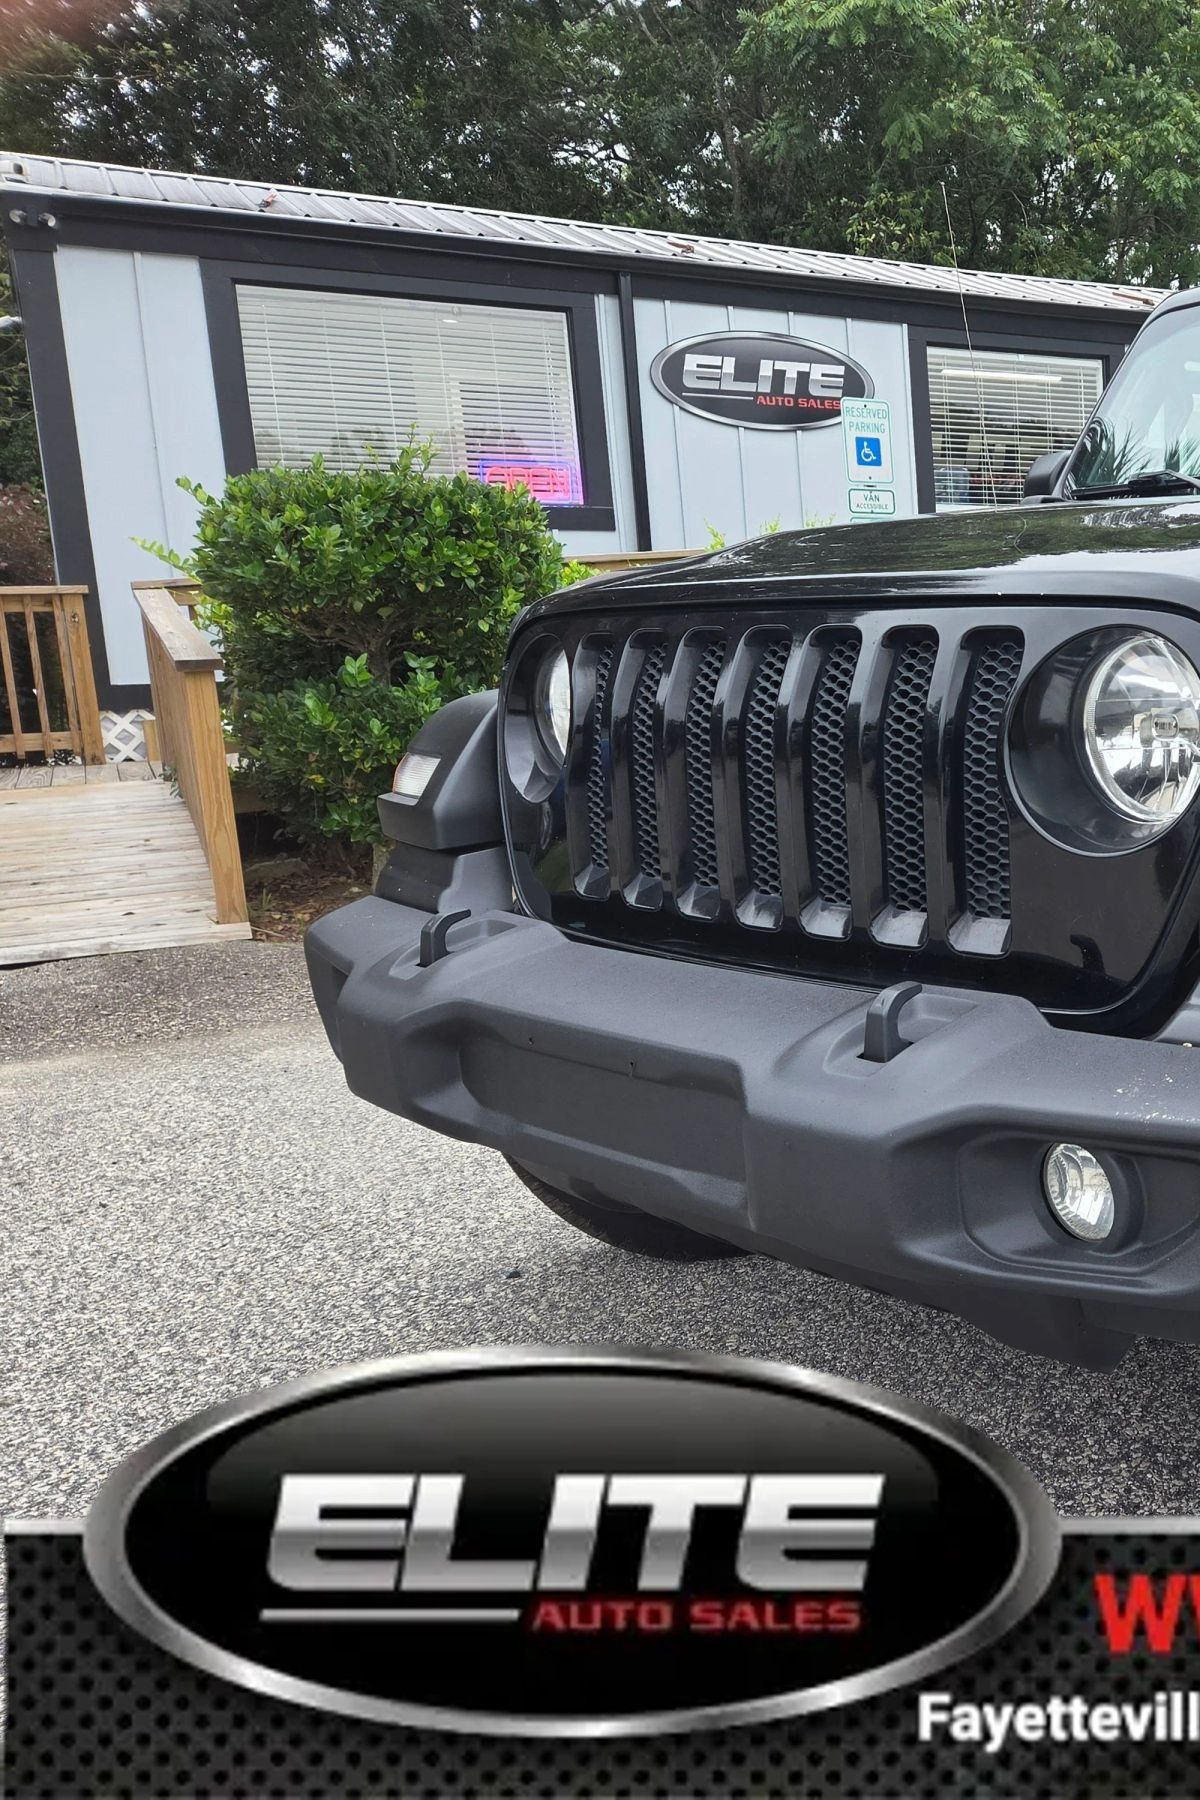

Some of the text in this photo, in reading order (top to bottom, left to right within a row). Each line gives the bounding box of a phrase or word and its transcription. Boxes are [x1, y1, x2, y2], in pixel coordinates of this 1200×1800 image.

[682, 353, 845, 398] ELITE
[756, 395, 841, 410] AUTO SALES
[845, 406, 888, 420] RESERVED
[849, 420, 886, 434] PARKING
[863, 493, 880, 503] VAN
[855, 502, 889, 510] ACCESSIBLE
